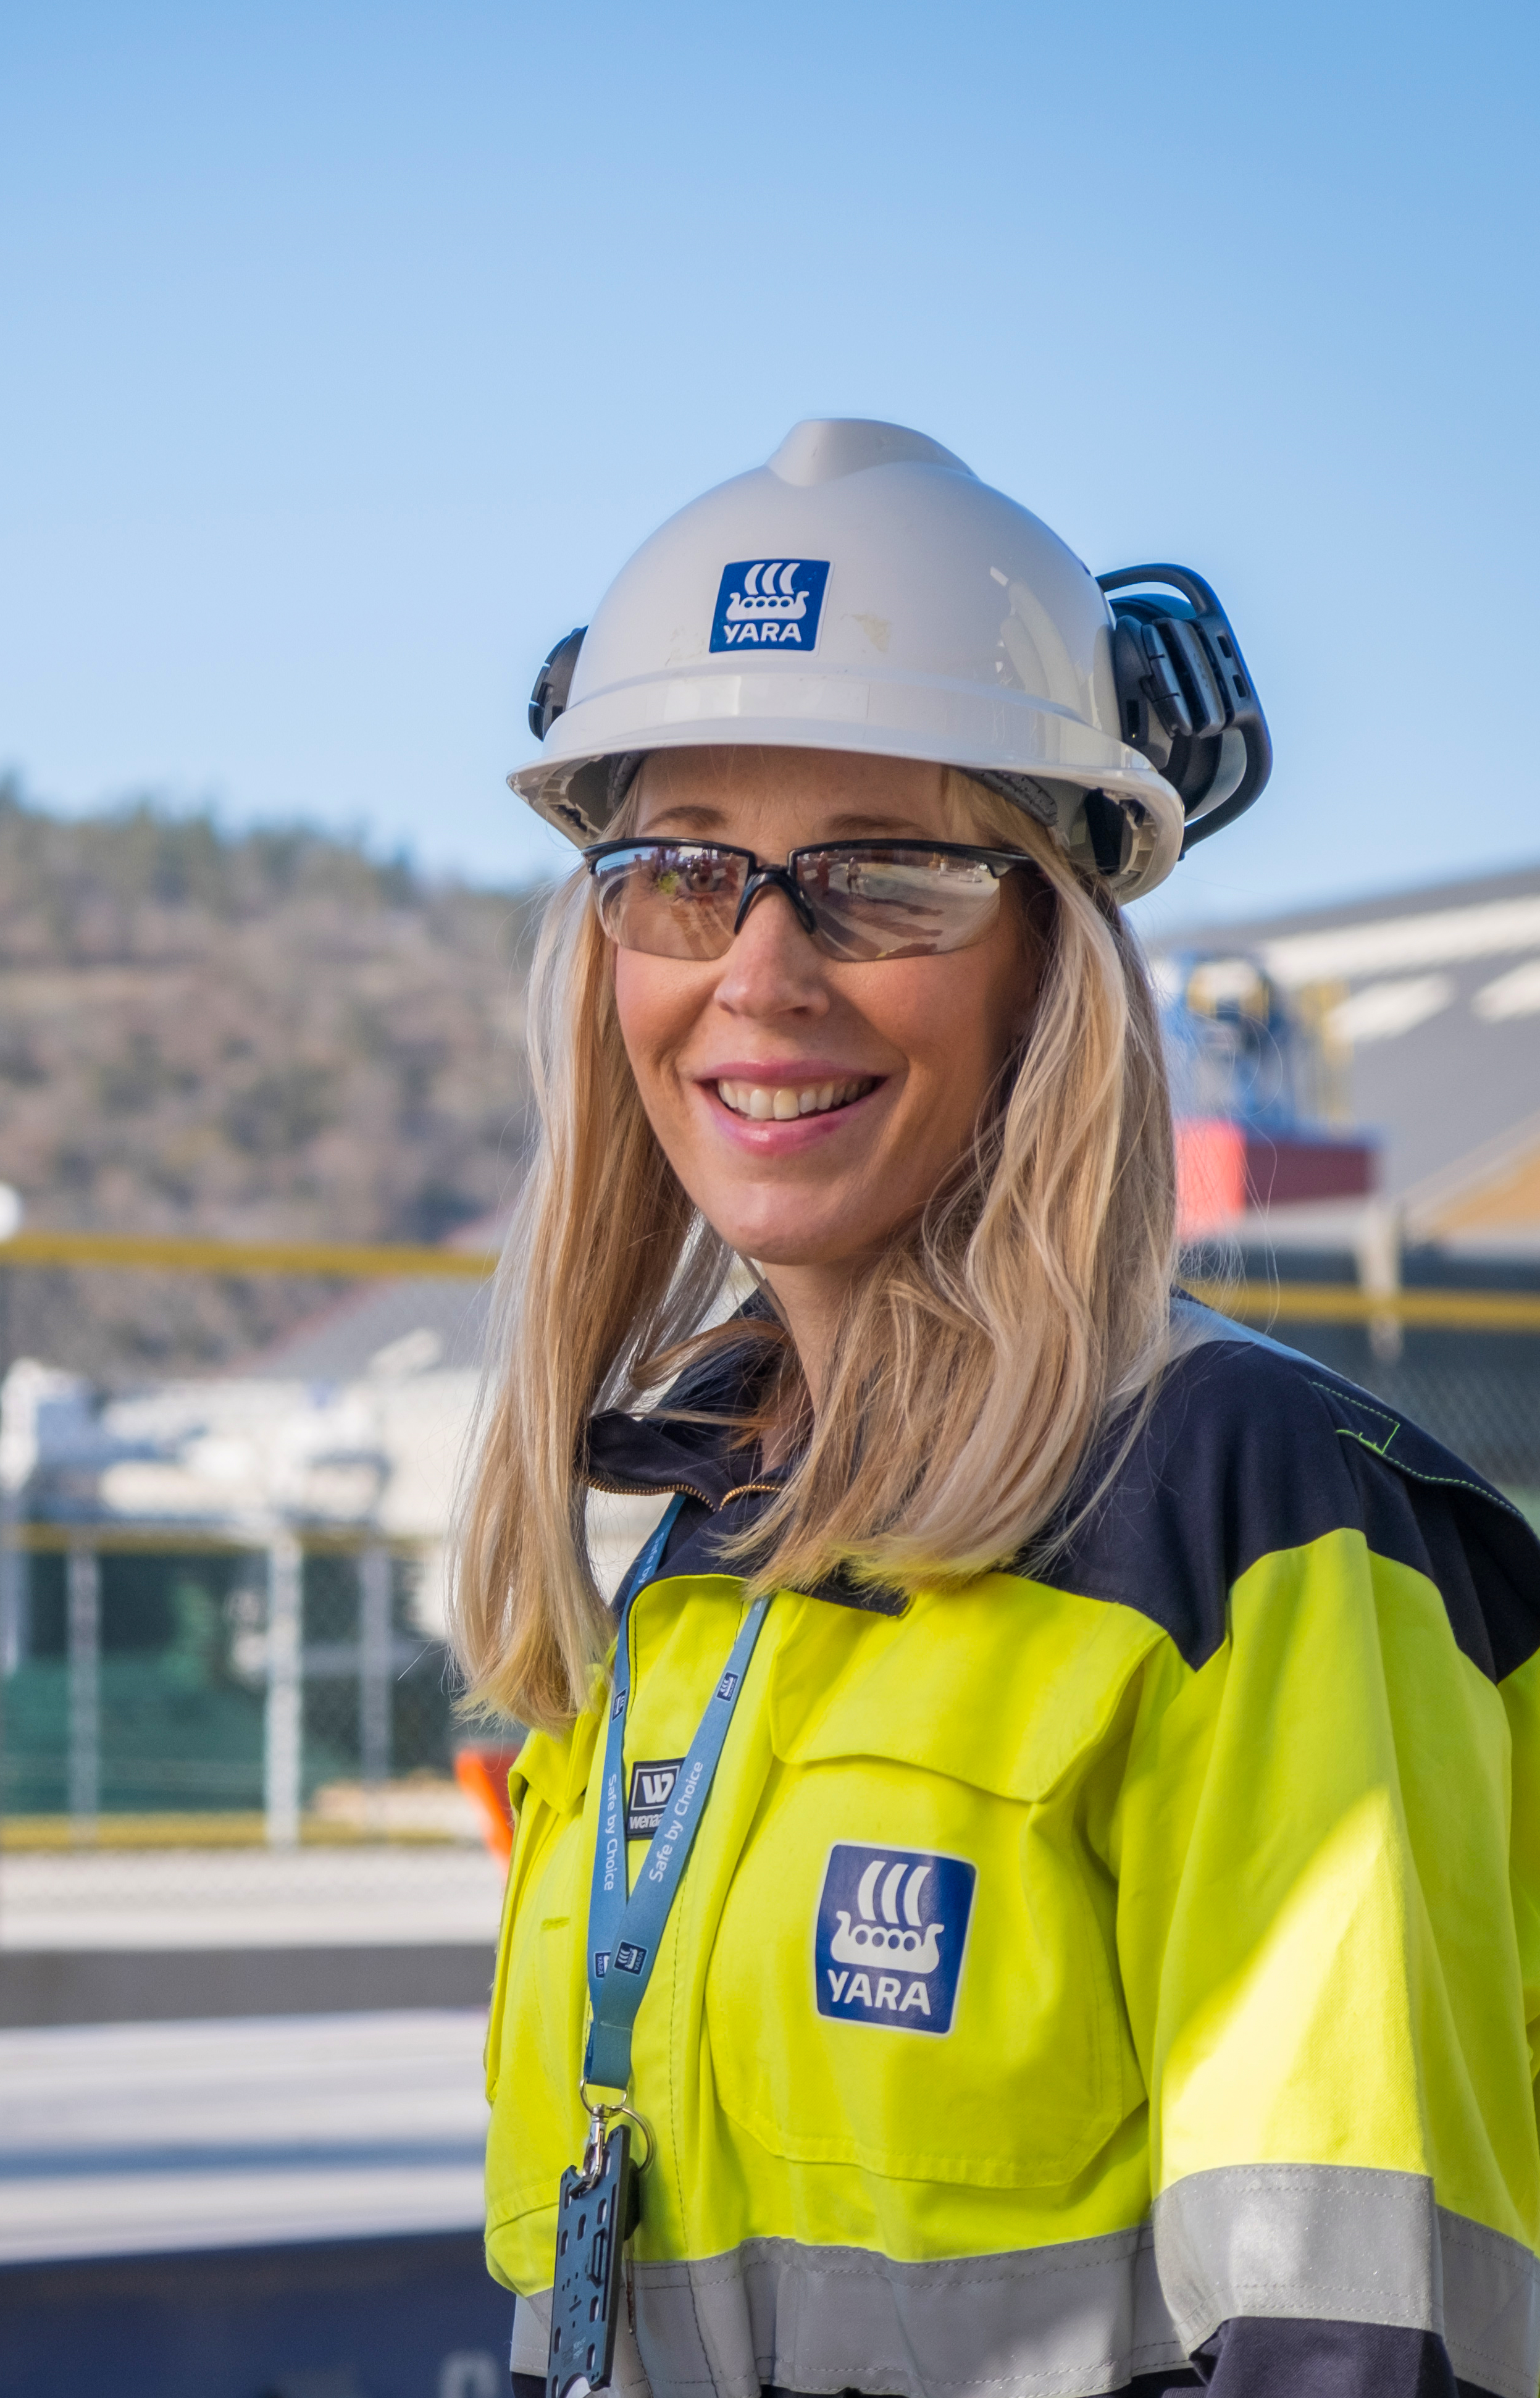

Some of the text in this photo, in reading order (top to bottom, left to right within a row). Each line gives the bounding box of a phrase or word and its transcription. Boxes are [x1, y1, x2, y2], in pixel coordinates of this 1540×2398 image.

[723, 622, 802, 644] YARA
[604, 1773, 618, 1891] Safe by Choice
[649, 1761, 703, 1882] Safe by Choice
[827, 1969, 931, 2016] YARA
